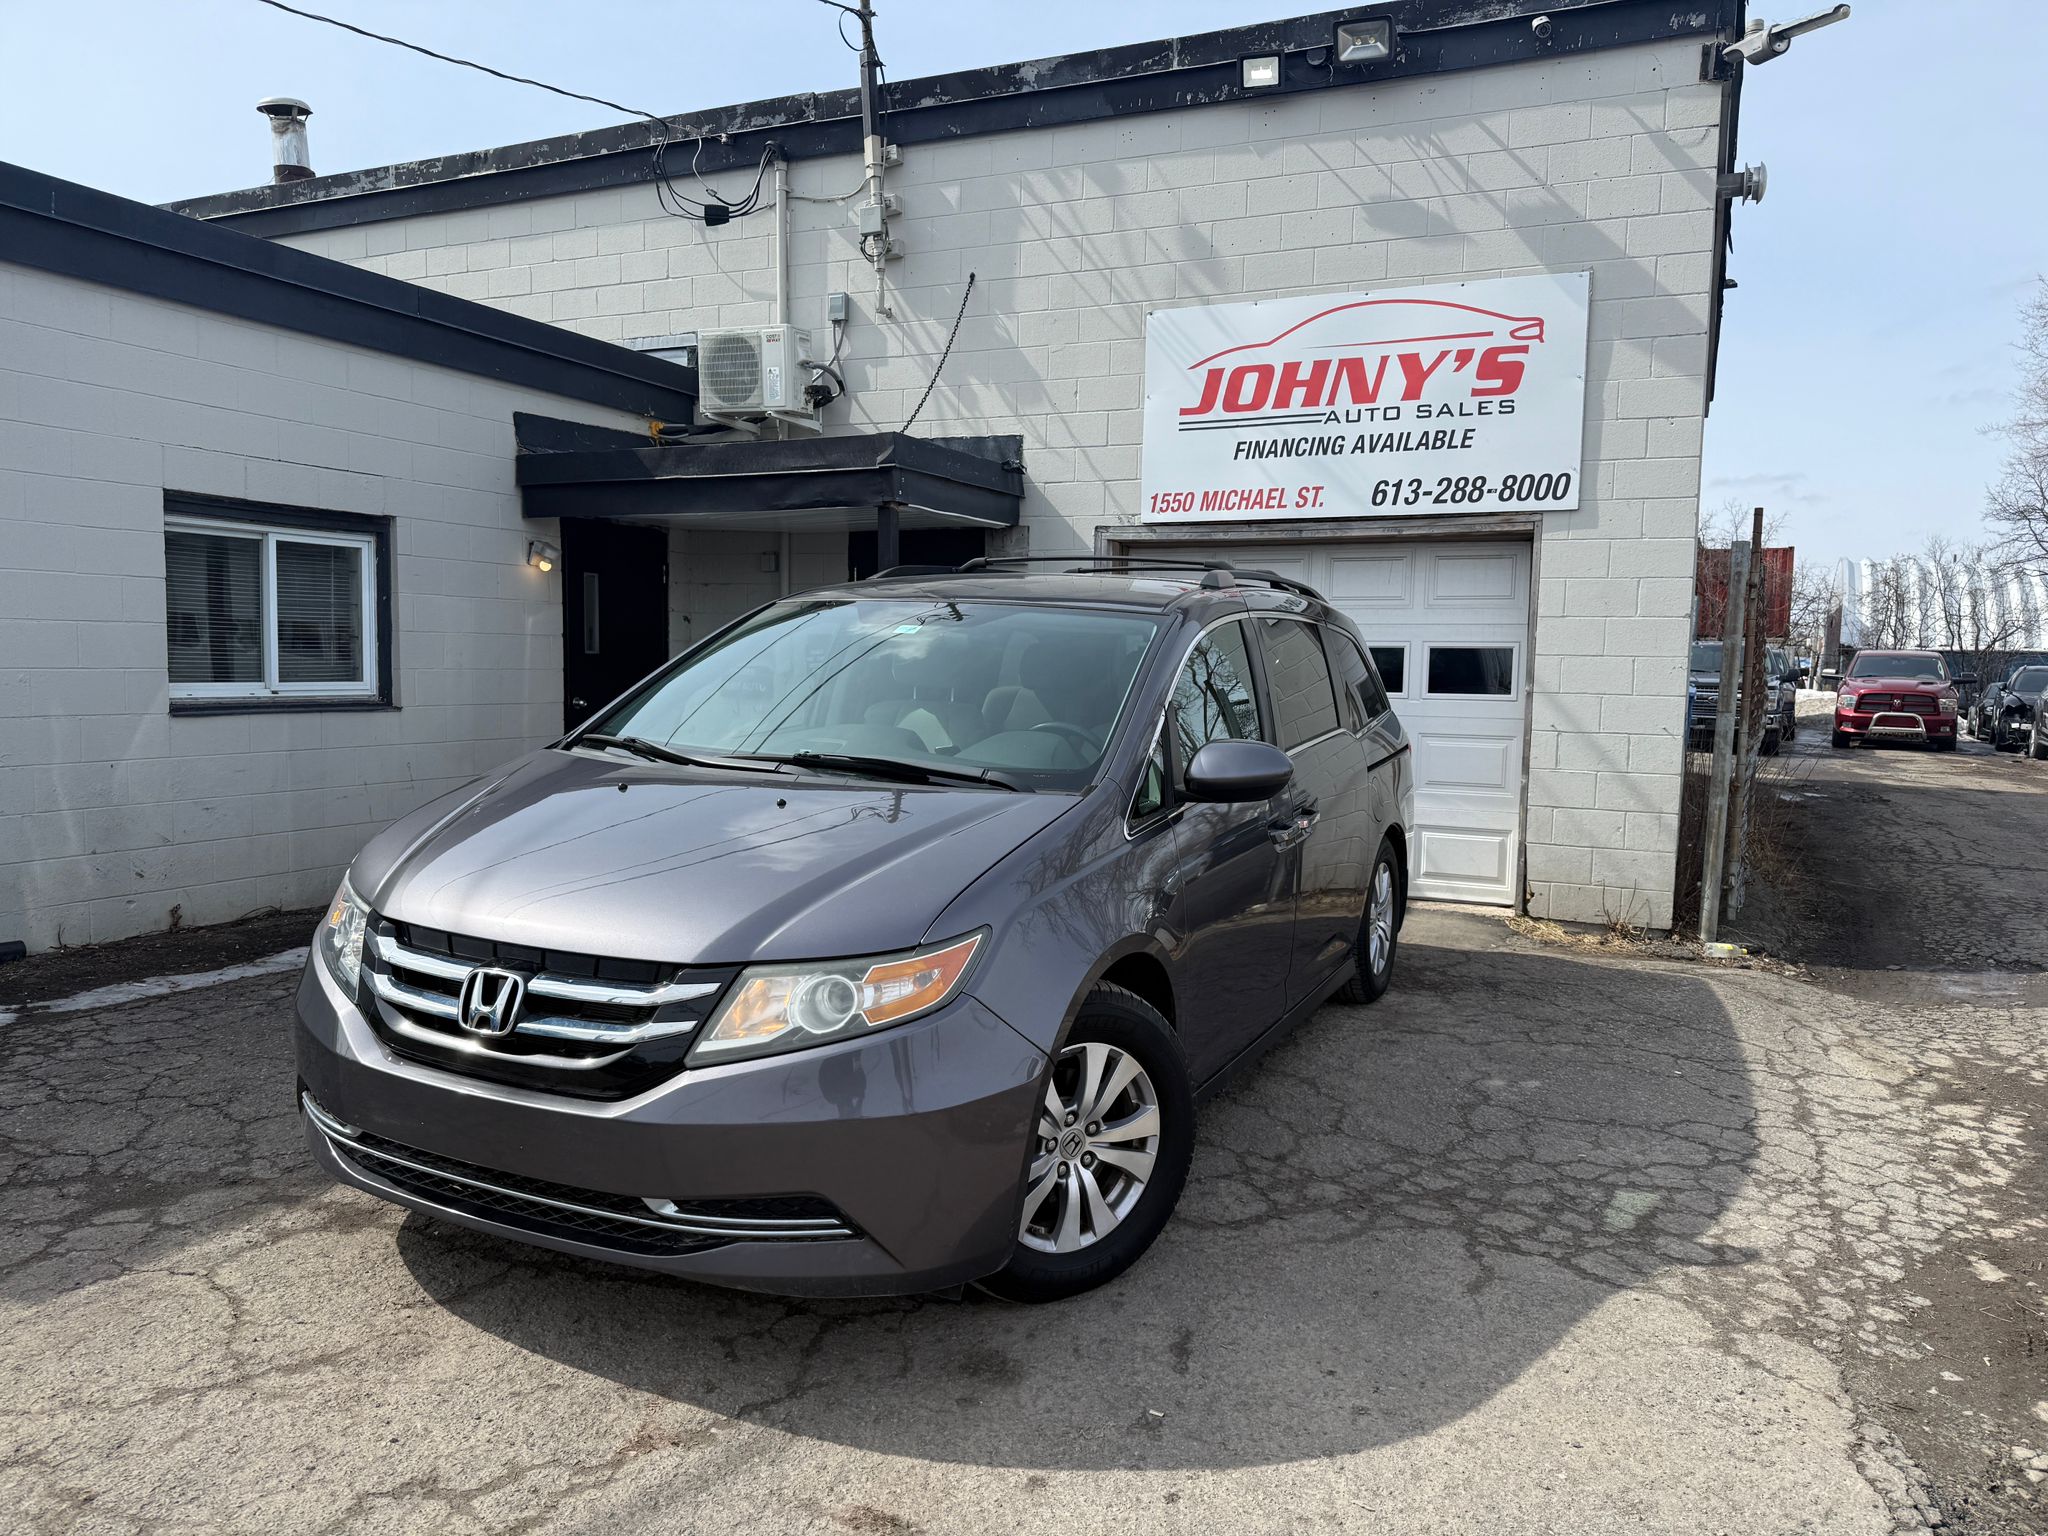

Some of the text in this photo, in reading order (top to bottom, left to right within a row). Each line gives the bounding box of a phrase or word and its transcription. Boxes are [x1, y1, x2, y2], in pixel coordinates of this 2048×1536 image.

[1179, 345, 1530, 416] JOHNY'S
[1324, 399, 1516, 424] AUTO SALES
[1233, 428, 1476, 460] FINANCING AVAILABLE
[1150, 486, 1325, 513] 1550 MICHAEL ST.
[1371, 472, 1572, 507] 613-288-8000
